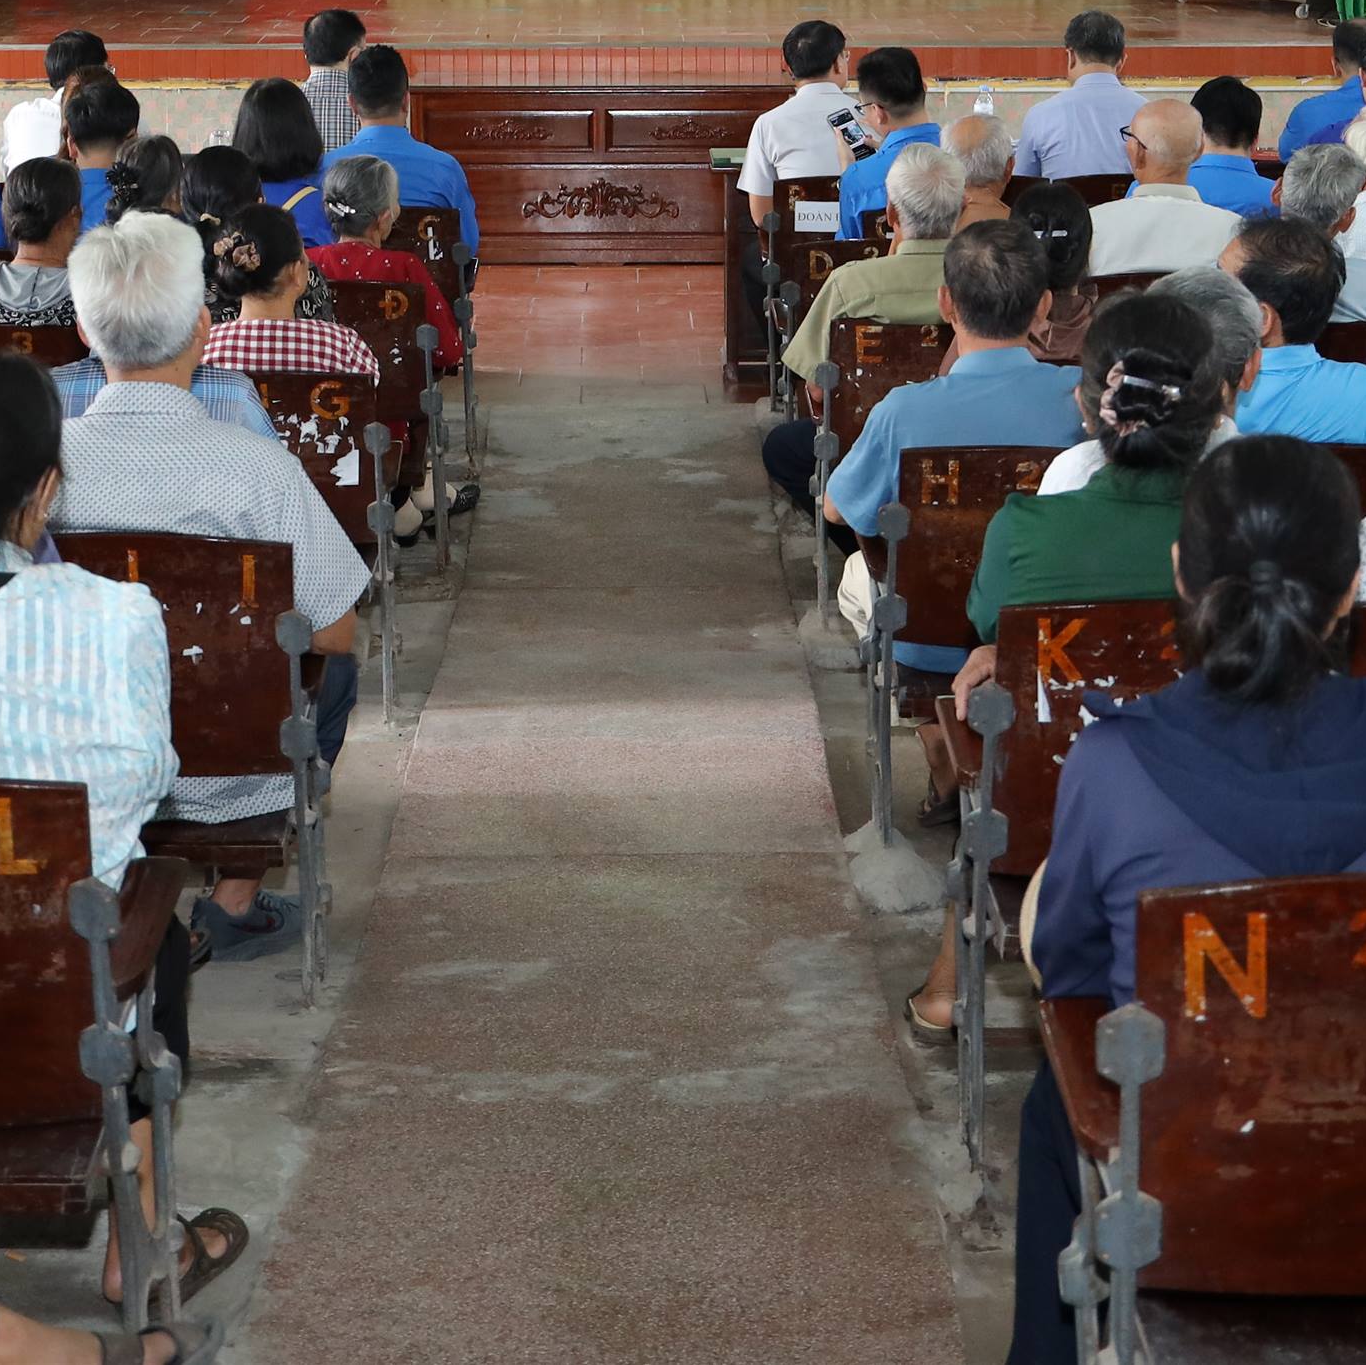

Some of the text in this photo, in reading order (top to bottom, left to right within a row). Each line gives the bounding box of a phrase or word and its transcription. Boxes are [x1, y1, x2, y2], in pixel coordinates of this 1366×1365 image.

[797, 211, 833, 222] ĐOÀN
[809, 250, 833, 280] D
[12, 331, 33, 354] 3
[855, 324, 939, 364] E 2
[310, 380, 351, 420] G
[921, 459, 1042, 505] H 2
[1037, 618, 1088, 680] K
[1184, 912, 1269, 1020] N
